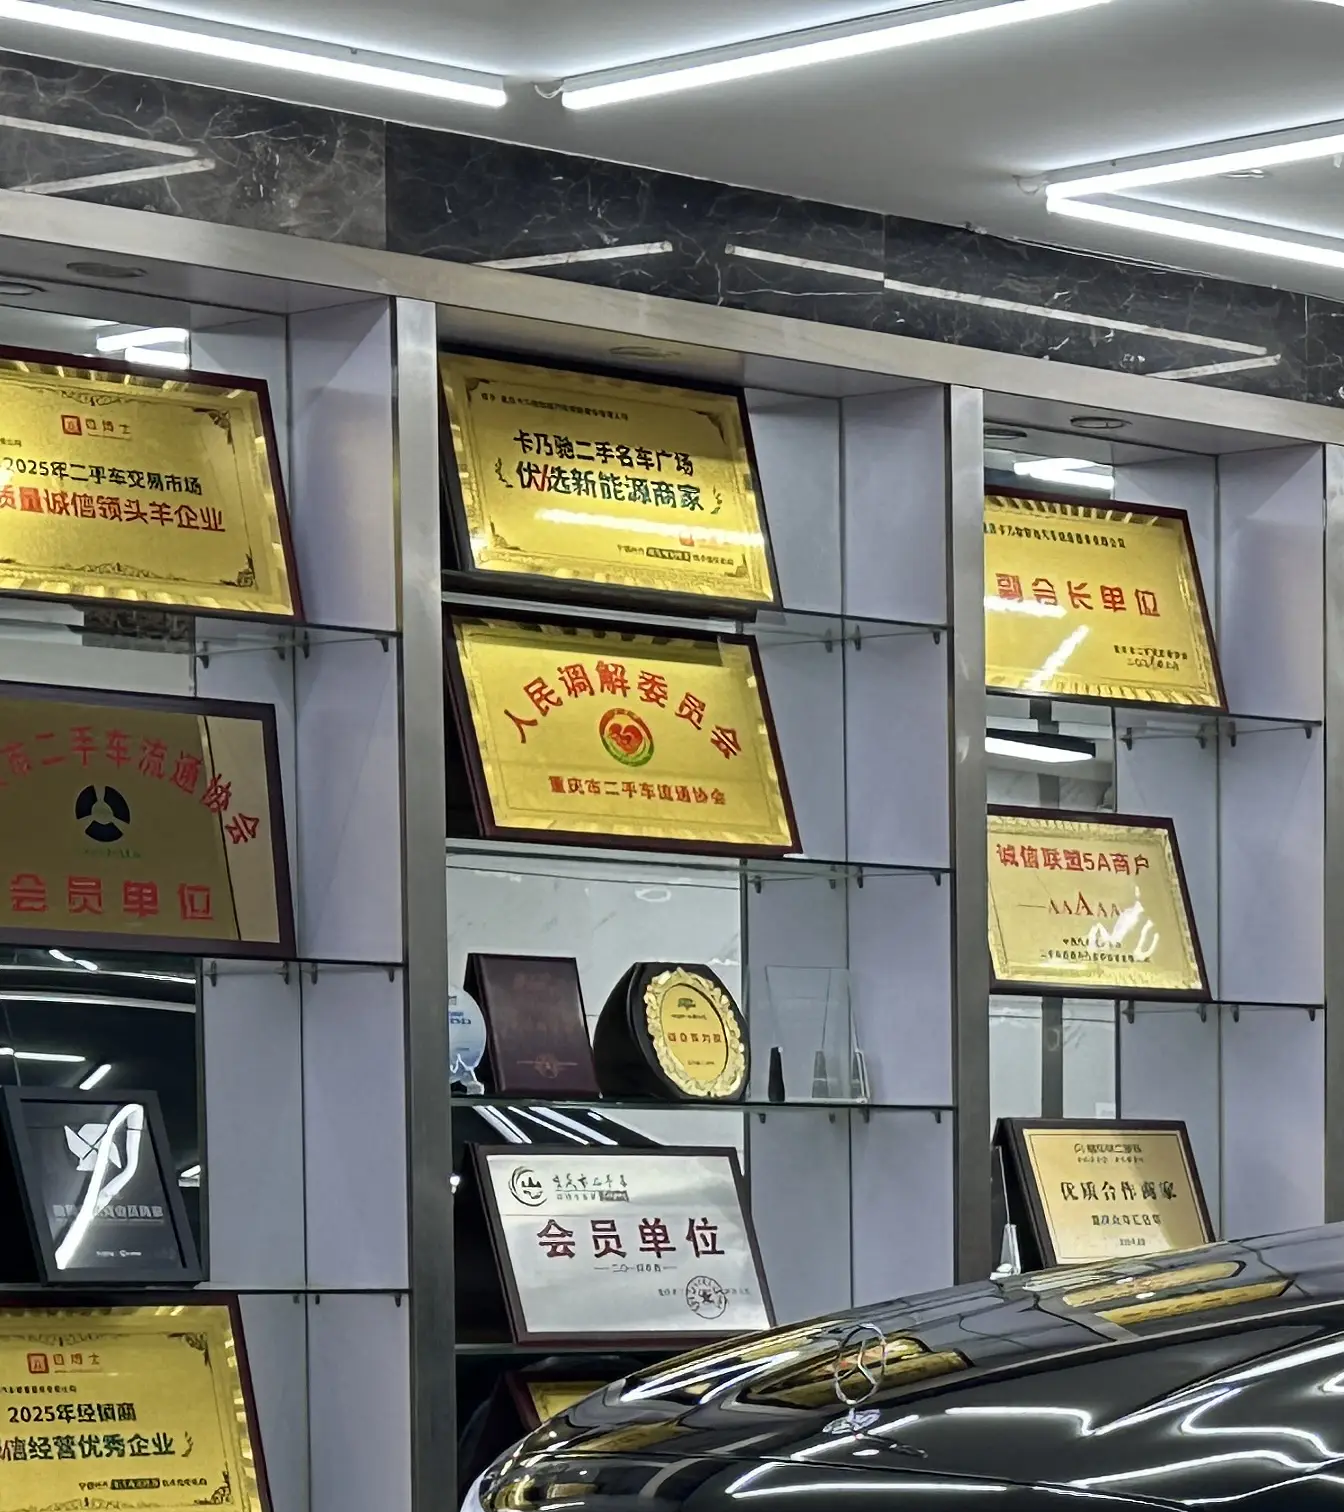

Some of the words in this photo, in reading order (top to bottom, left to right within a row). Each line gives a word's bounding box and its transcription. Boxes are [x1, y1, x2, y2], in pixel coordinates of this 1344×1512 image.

[513, 429, 694, 477] 卡乃驰二手名车广场
[2, 456, 203, 496] 2025年二手车交易市场
[516, 461, 705, 513] 优选新能源商家
[503, 660, 742, 760] 人民调解委员会
[547, 775, 728, 807] 重庆市二手车流通协会
[995, 843, 1150, 876] 诚信联盟5A商户
[9, 872, 214, 921] 会员单位
[536, 1217, 726, 1260] 会员单位
[0, 1431, 176, 1462] 信经营优秀企业
